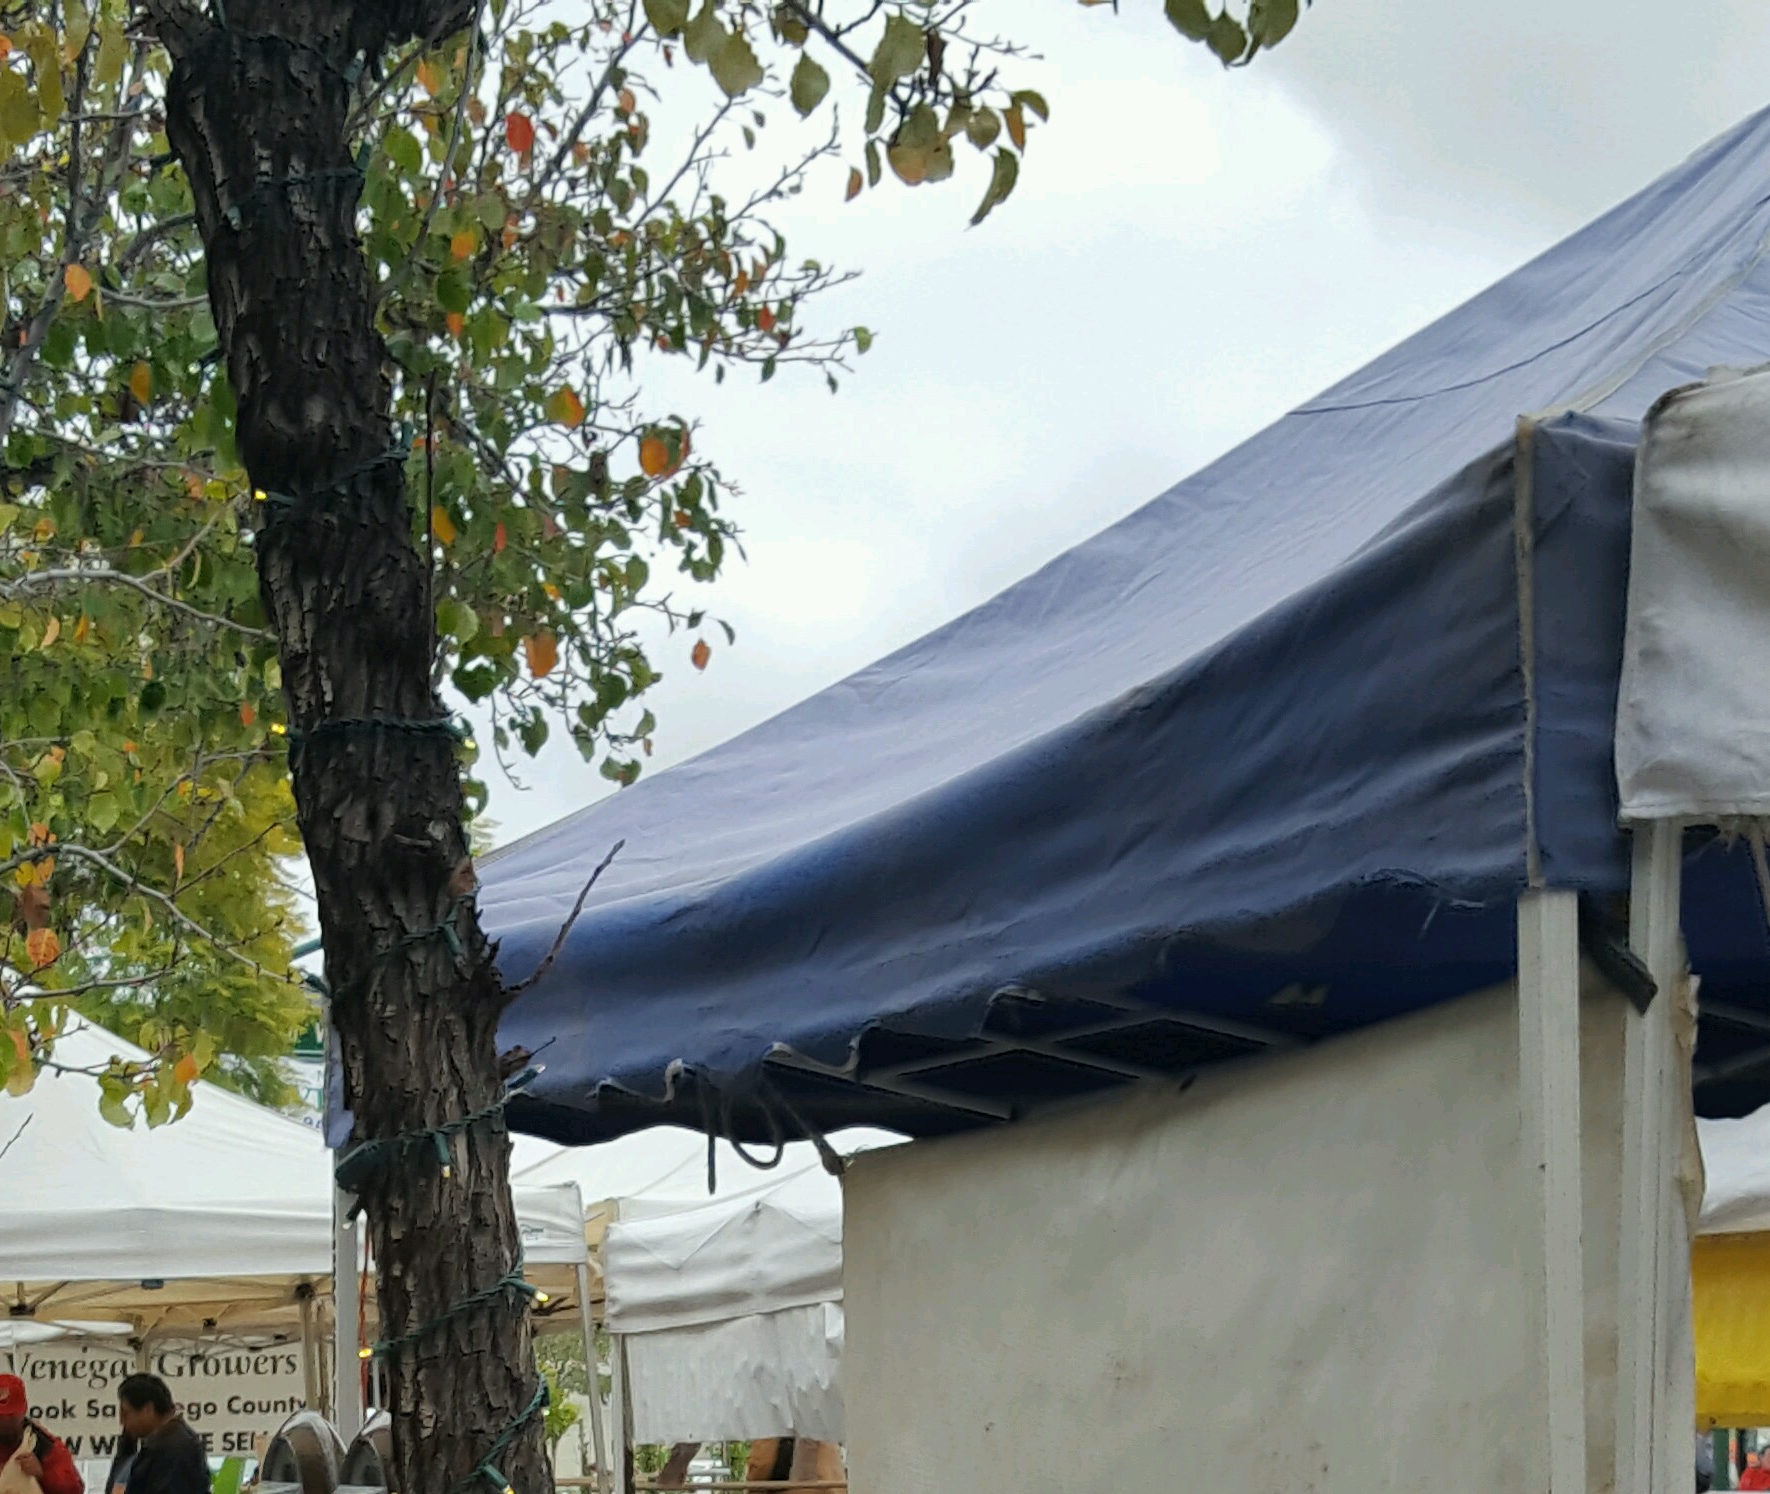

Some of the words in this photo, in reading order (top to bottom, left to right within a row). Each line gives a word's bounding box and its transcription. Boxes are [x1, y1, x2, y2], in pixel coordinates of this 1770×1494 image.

[4, 1352, 136, 1390] Venega
[157, 1352, 298, 1378] Growers
[86, 1398, 117, 1418] Sa
